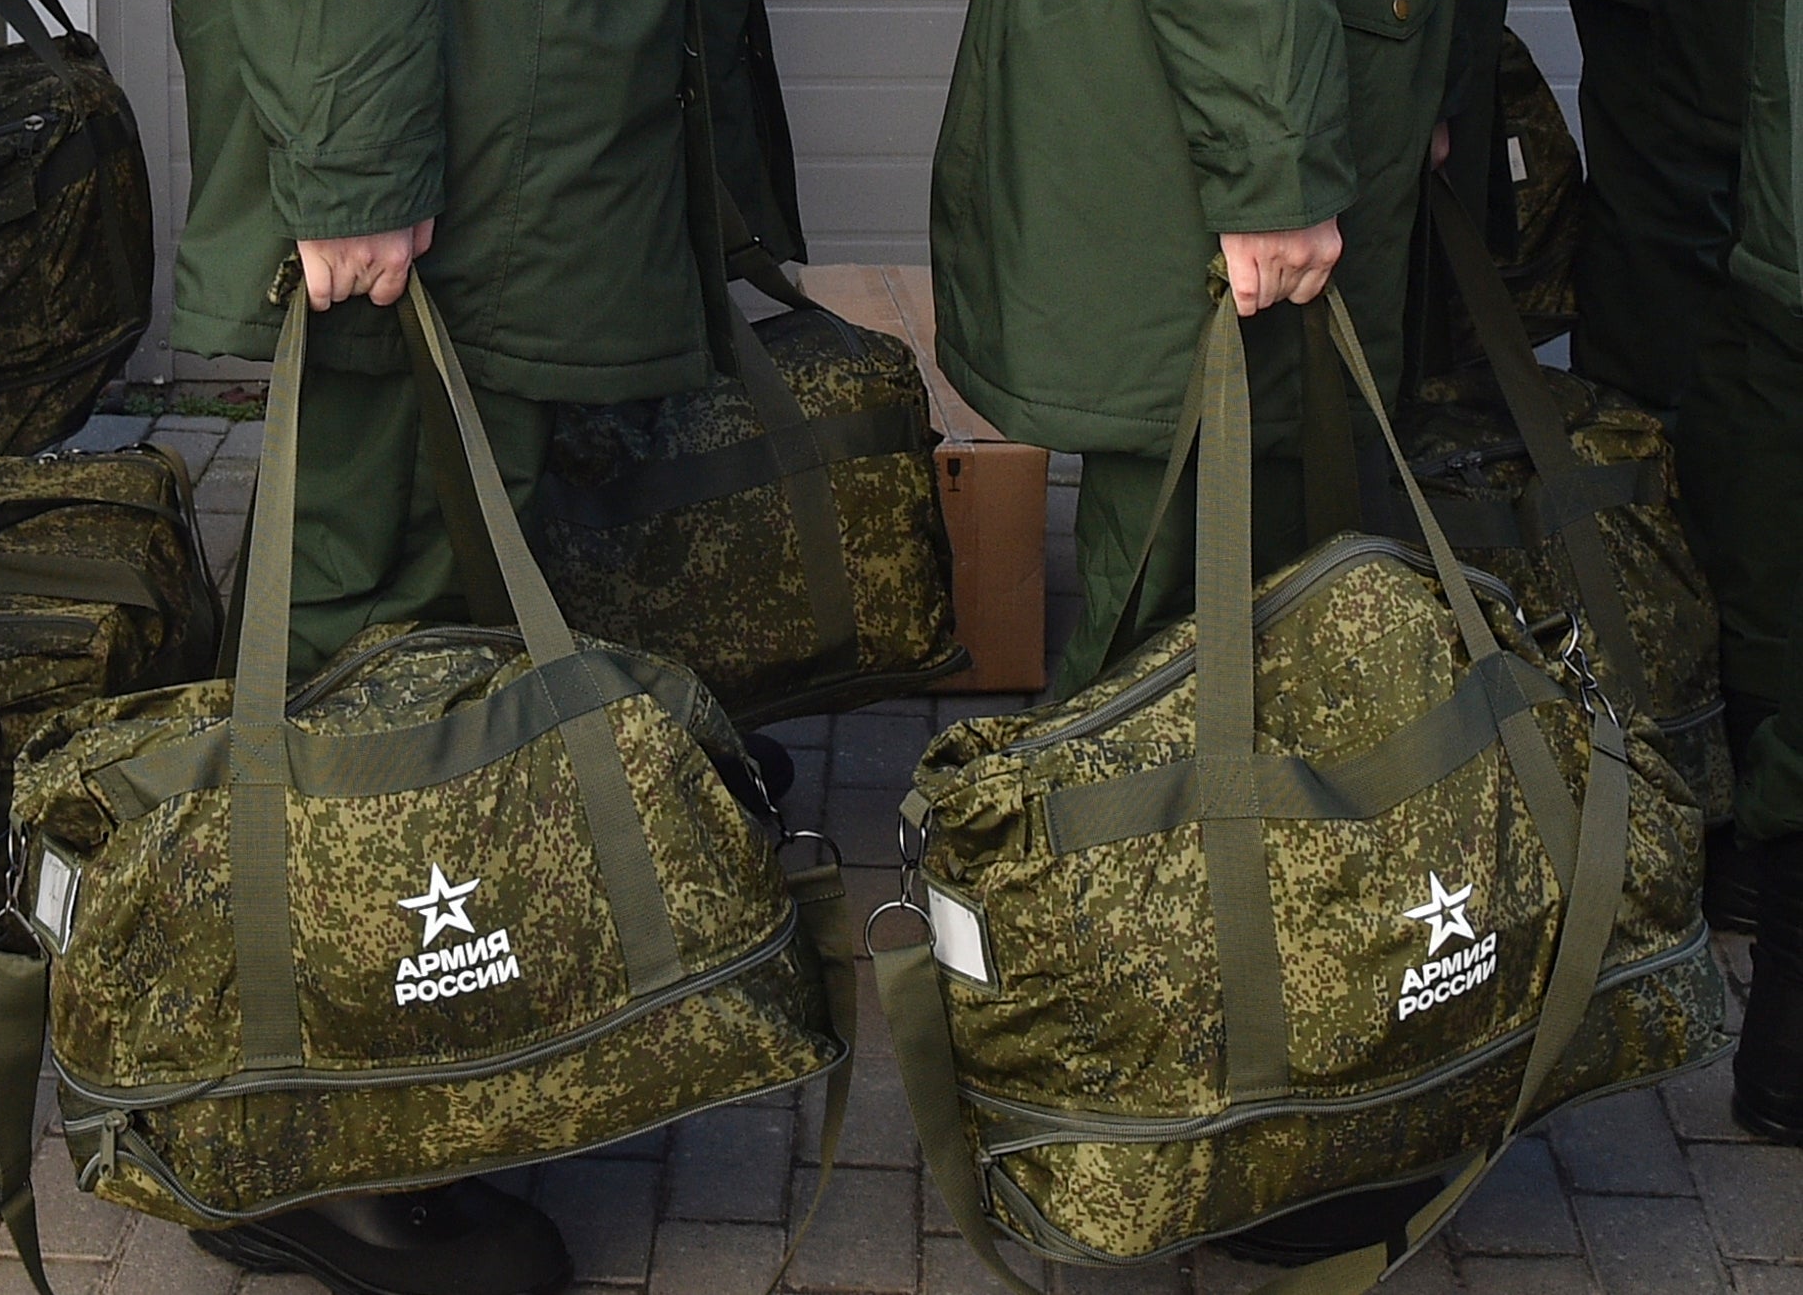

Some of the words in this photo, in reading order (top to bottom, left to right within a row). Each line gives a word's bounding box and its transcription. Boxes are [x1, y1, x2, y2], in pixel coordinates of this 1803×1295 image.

[395, 955, 519, 1005] РОССИИ
[396, 928, 510, 981] АРМИЯ
[1401, 932, 1496, 995] АРМИЯ
[1399, 954, 1496, 1021] РОССИИ
